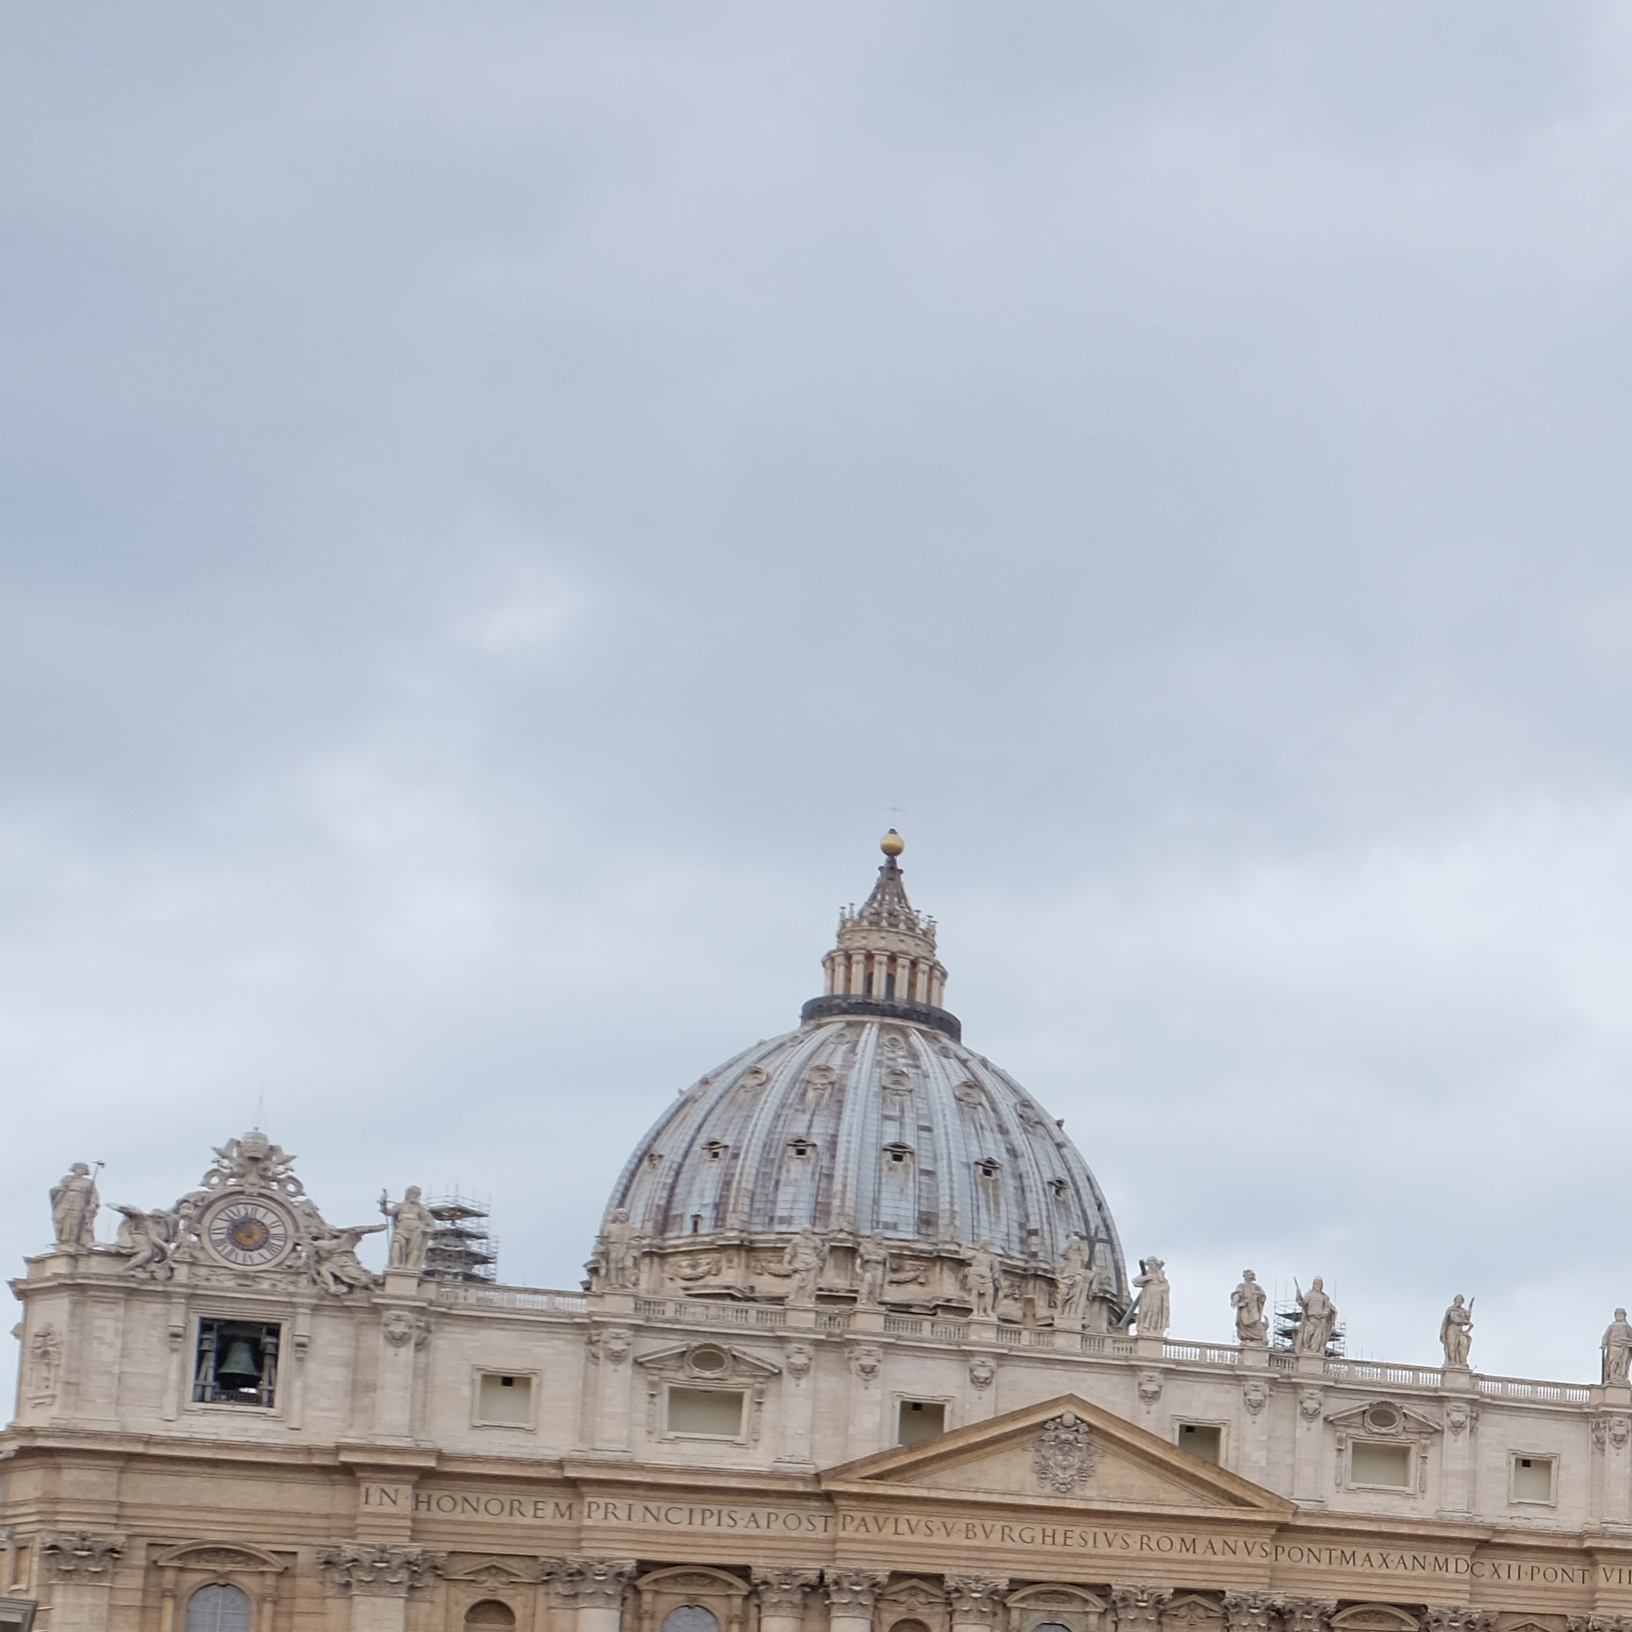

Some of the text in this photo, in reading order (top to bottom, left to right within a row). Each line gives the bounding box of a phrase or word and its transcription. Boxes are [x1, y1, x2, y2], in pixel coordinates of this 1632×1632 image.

[363, 1487, 399, 1506] IN
[413, 1492, 575, 1521] HONOREM
[586, 1501, 739, 1528] PRINCIPIS
[743, 1511, 834, 1533] APOST
[841, 1514, 934, 1538] PAVLVS
[964, 1522, 1131, 1550] BVRGHESIVS
[1139, 1534, 1270, 1559] ROMANVS
[1273, 1544, 1337, 1566] PONT
[1339, 1550, 1391, 1569] MAX
[1529, 1566, 1590, 1585] PONT
